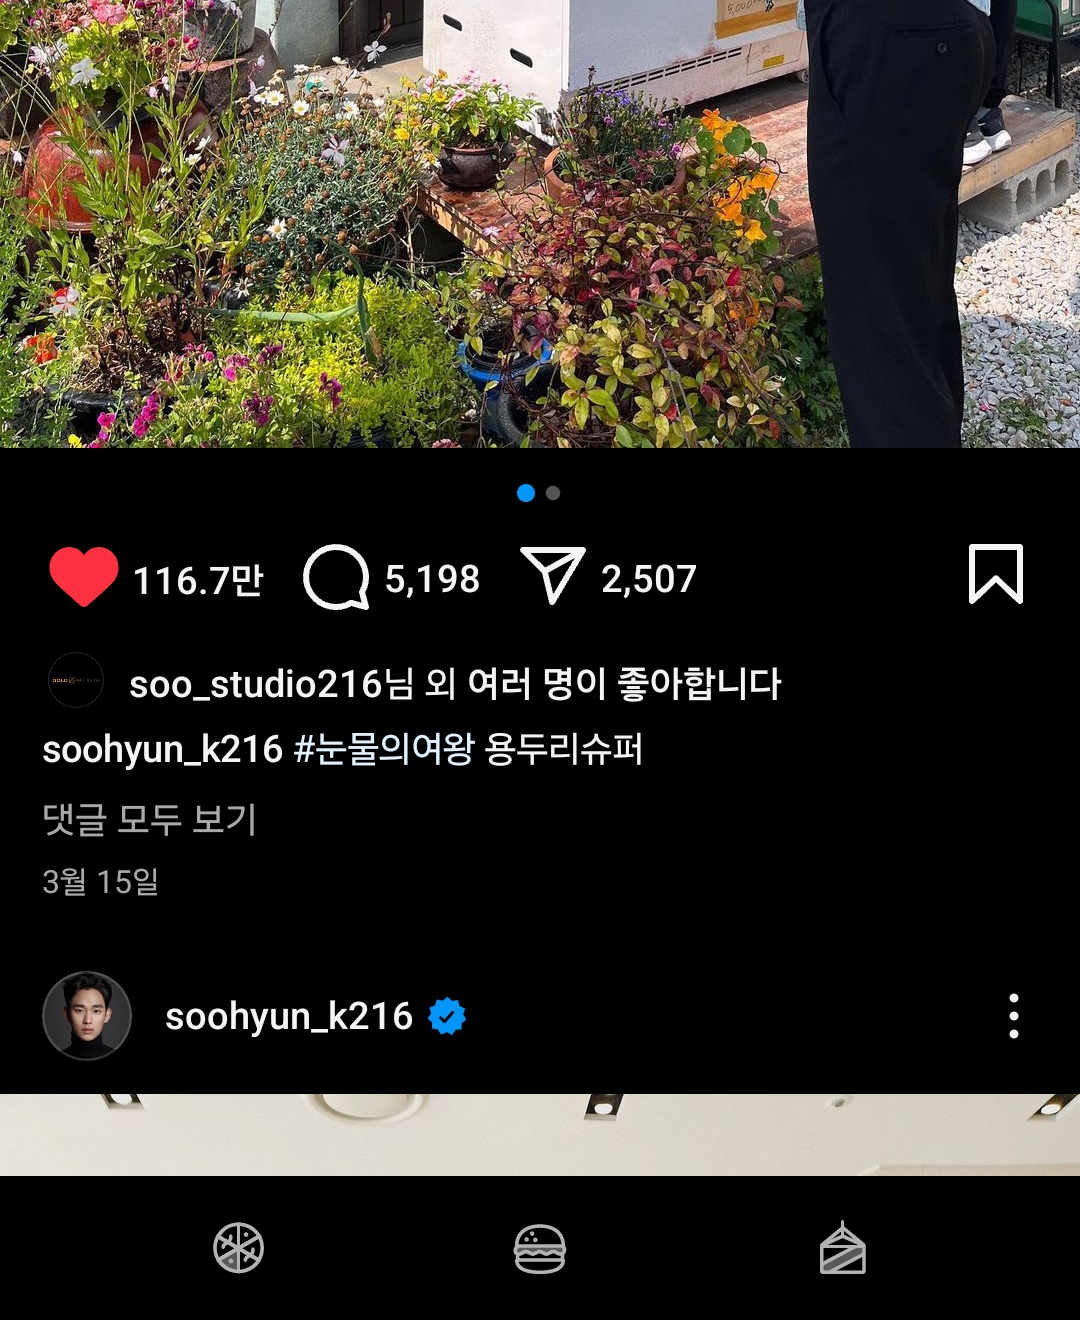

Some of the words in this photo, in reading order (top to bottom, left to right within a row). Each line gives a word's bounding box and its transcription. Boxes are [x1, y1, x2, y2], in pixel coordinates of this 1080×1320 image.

[133, 563, 265, 597] 116.7만
[385, 563, 480, 599] 5,198
[601, 563, 697, 599] 2,507
[129, 666, 413, 702] soo_studio216님
[424, 666, 455, 701] 외
[468, 666, 530, 701] 여러
[544, 666, 605, 702] 명이
[617, 666, 783, 703] 좋아합니다
[42, 732, 283, 771] soohyun_k216
[293, 732, 476, 767] #눈물의여왕
[484, 732, 642, 767] 용두리슈퍼
[43, 803, 107, 837] 댓글
[117, 804, 182, 837] 모두
[192, 803, 255, 837] 보기
[42, 867, 86, 897] 3월
[98, 867, 158, 896] 15일
[165, 999, 413, 1038] soohyun_k216
